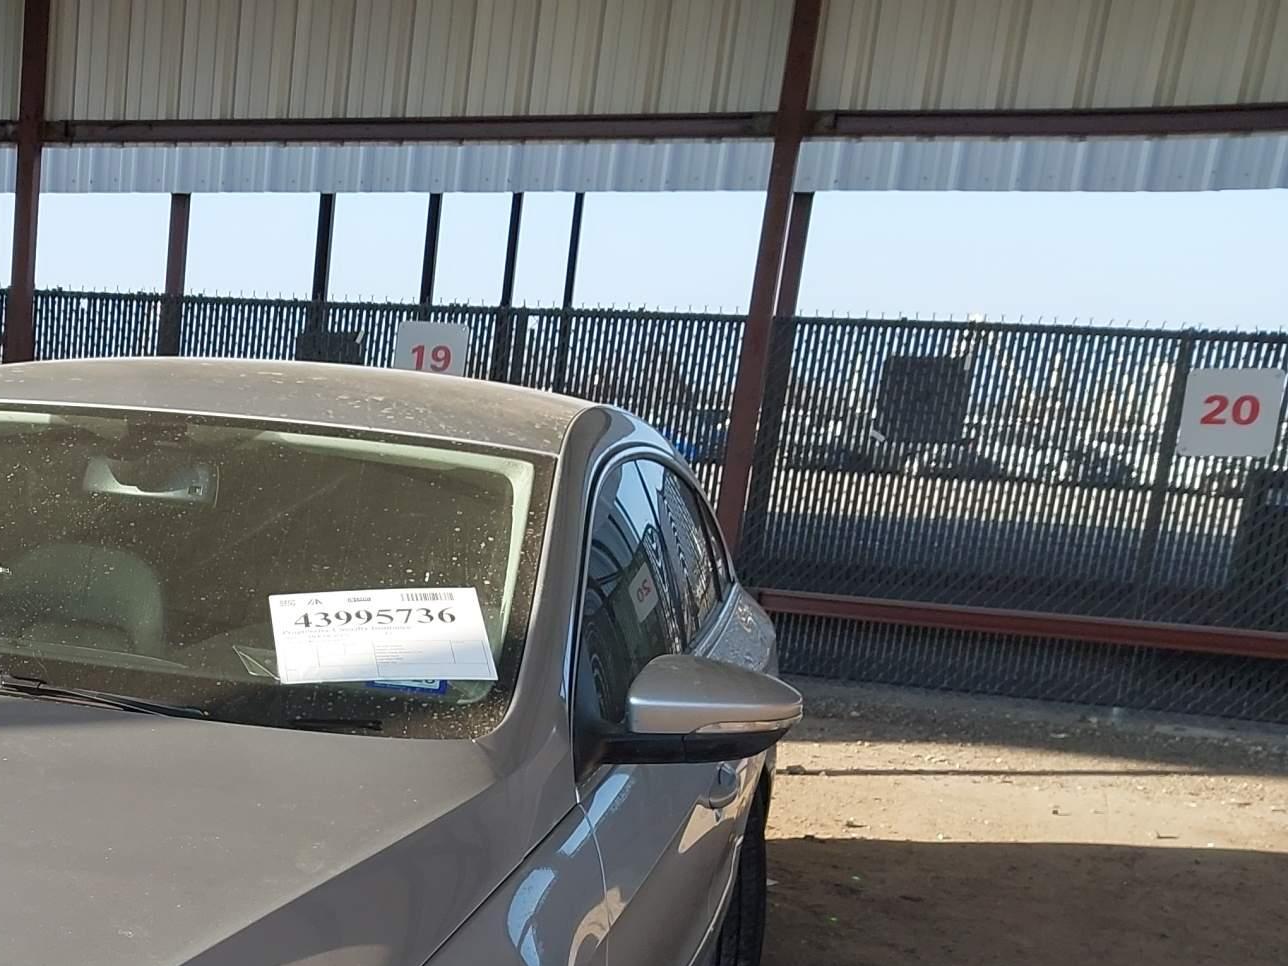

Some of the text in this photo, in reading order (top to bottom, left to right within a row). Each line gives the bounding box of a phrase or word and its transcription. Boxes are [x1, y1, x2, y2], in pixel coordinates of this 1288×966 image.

[411, 344, 452, 372] 19
[1199, 393, 1261, 426] 20
[293, 606, 457, 629] 43995736
